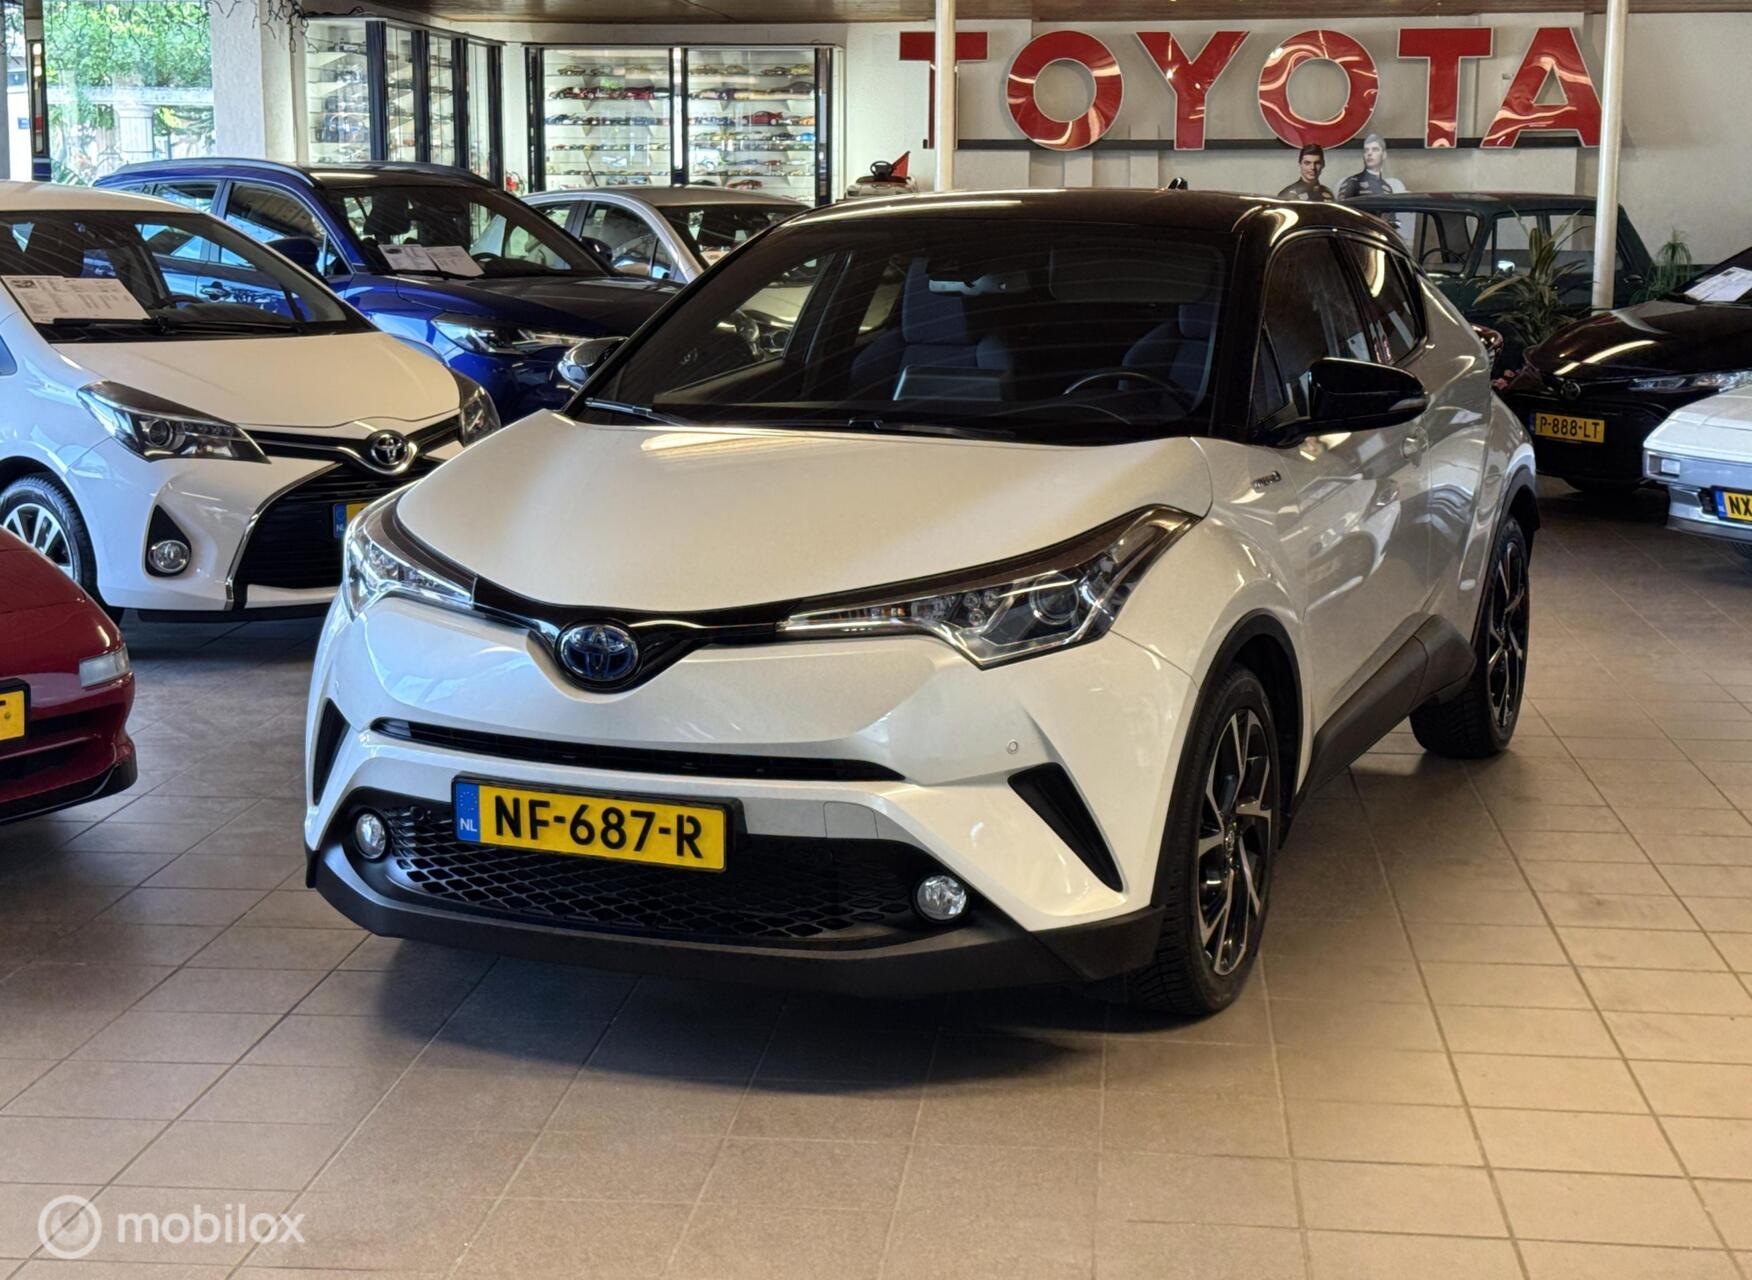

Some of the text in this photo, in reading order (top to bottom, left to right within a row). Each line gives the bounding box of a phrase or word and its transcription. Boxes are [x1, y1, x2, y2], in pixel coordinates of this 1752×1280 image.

[899, 27, 1602, 151] TOYOTA
[1540, 416, 1600, 439] P-888-LT
[460, 818, 477, 832] NL
[494, 795, 704, 859] NF-687-R
